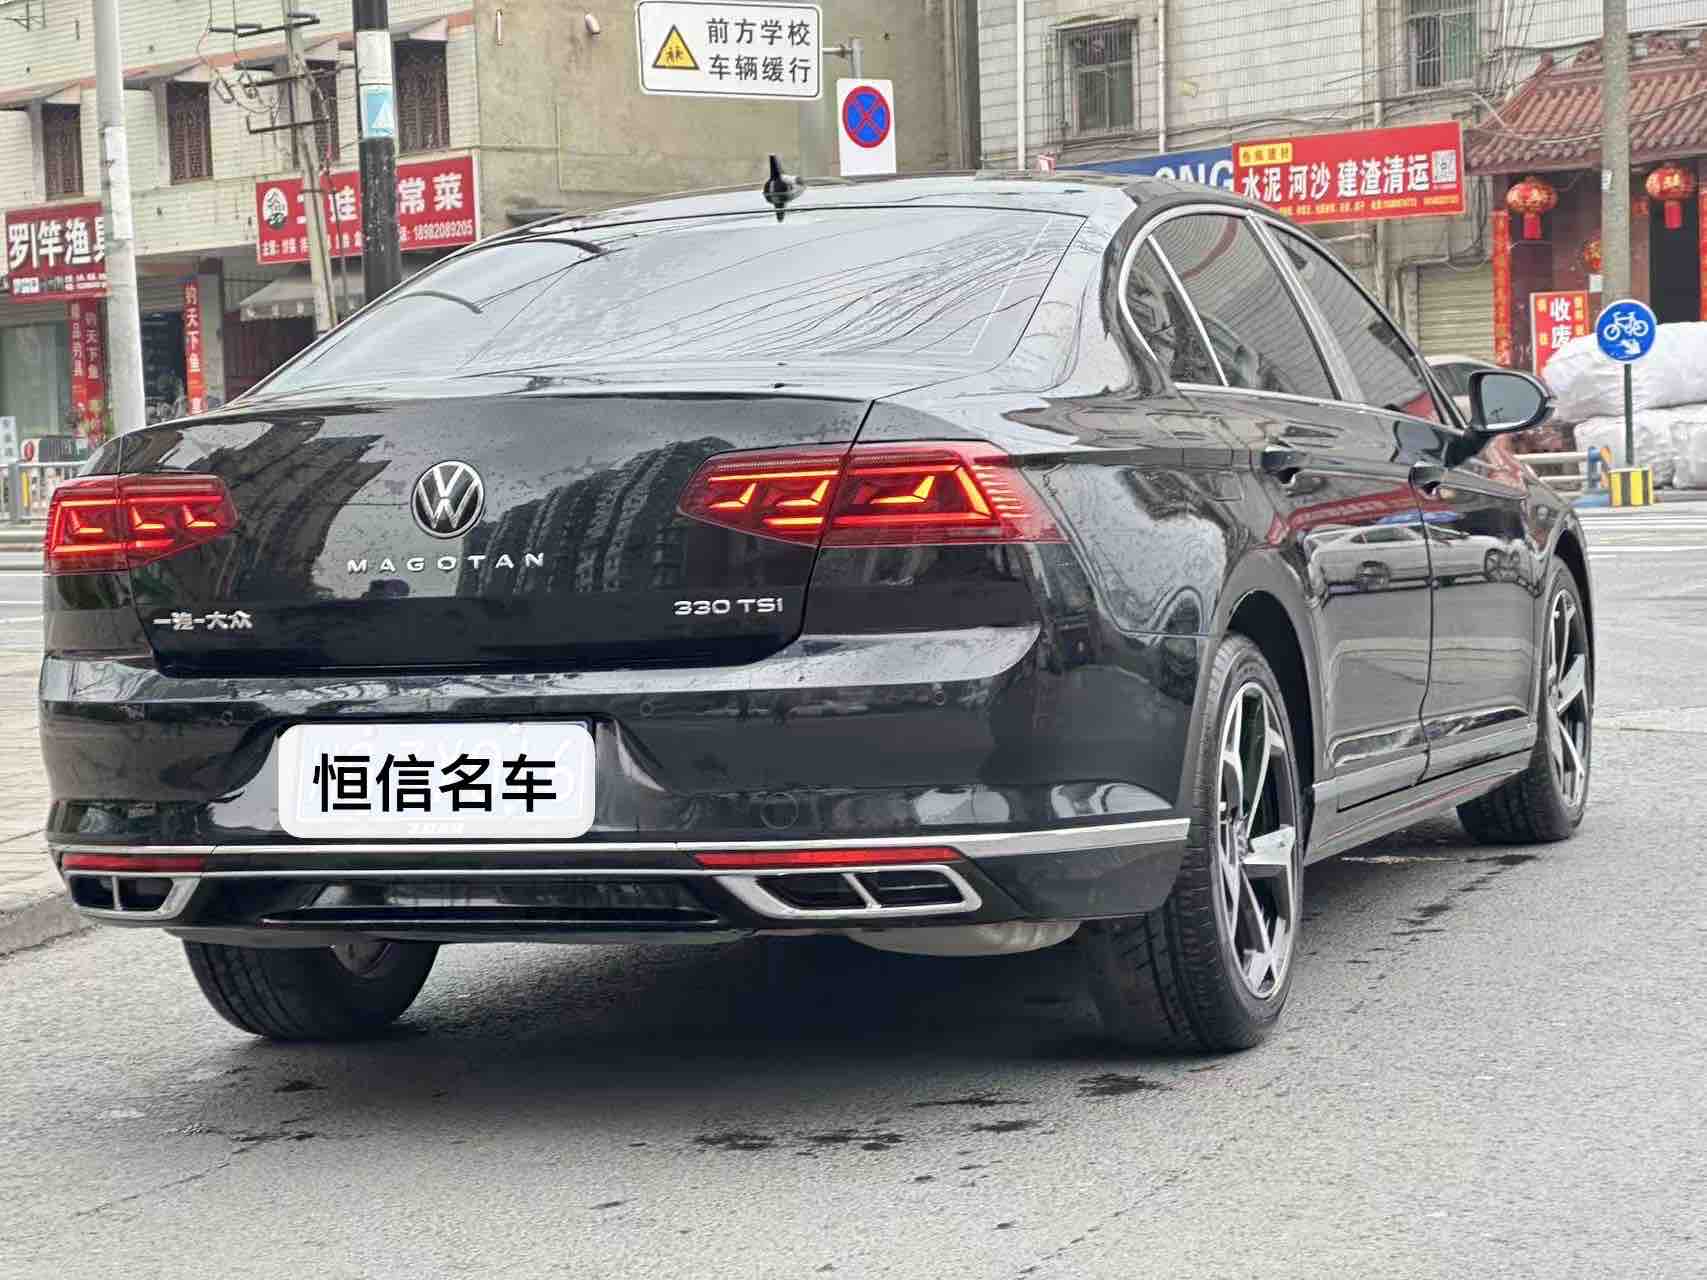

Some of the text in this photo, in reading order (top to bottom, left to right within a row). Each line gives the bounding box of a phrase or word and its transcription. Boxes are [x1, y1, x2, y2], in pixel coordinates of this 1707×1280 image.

[706, 17, 811, 46] 前方学校
[708, 54, 812, 83] 车辆缓行
[1241, 153, 1430, 202] 水泥 河沙 建渣清运
[346, 552, 545, 575] MAGOTAN
[673, 599, 731, 616] 330
